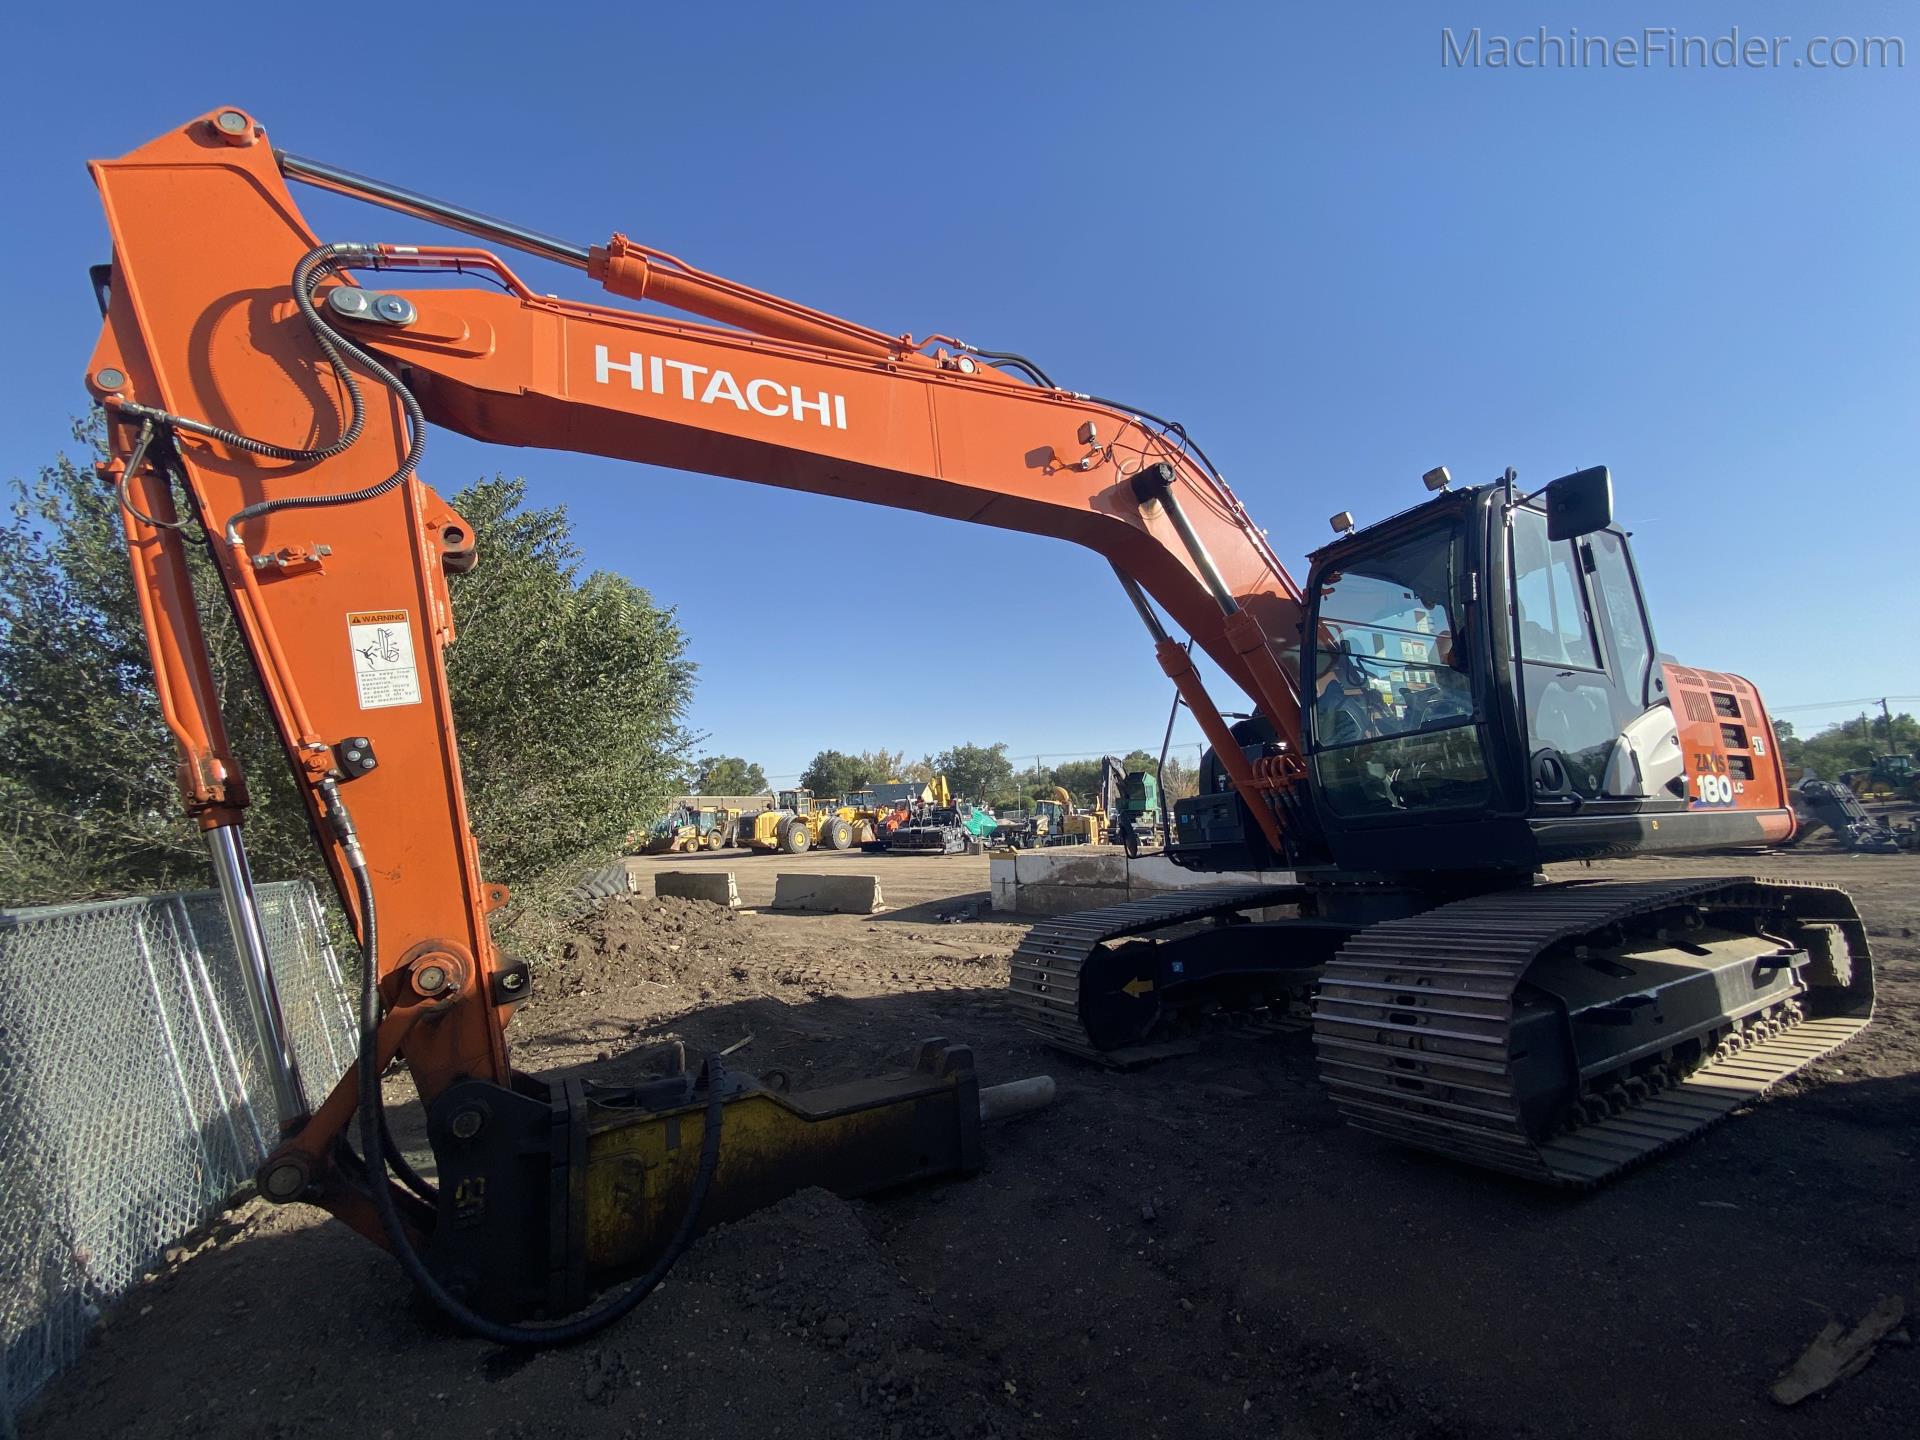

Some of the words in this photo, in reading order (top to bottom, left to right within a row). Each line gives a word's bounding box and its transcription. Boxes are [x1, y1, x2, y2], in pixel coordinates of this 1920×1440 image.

[595, 344, 847, 430] HITACHI
[362, 614, 404, 622] WARNING
[1695, 752, 1726, 773] ZAXIS
[1697, 774, 1732, 803] 180
[1733, 781, 1744, 794] LC
